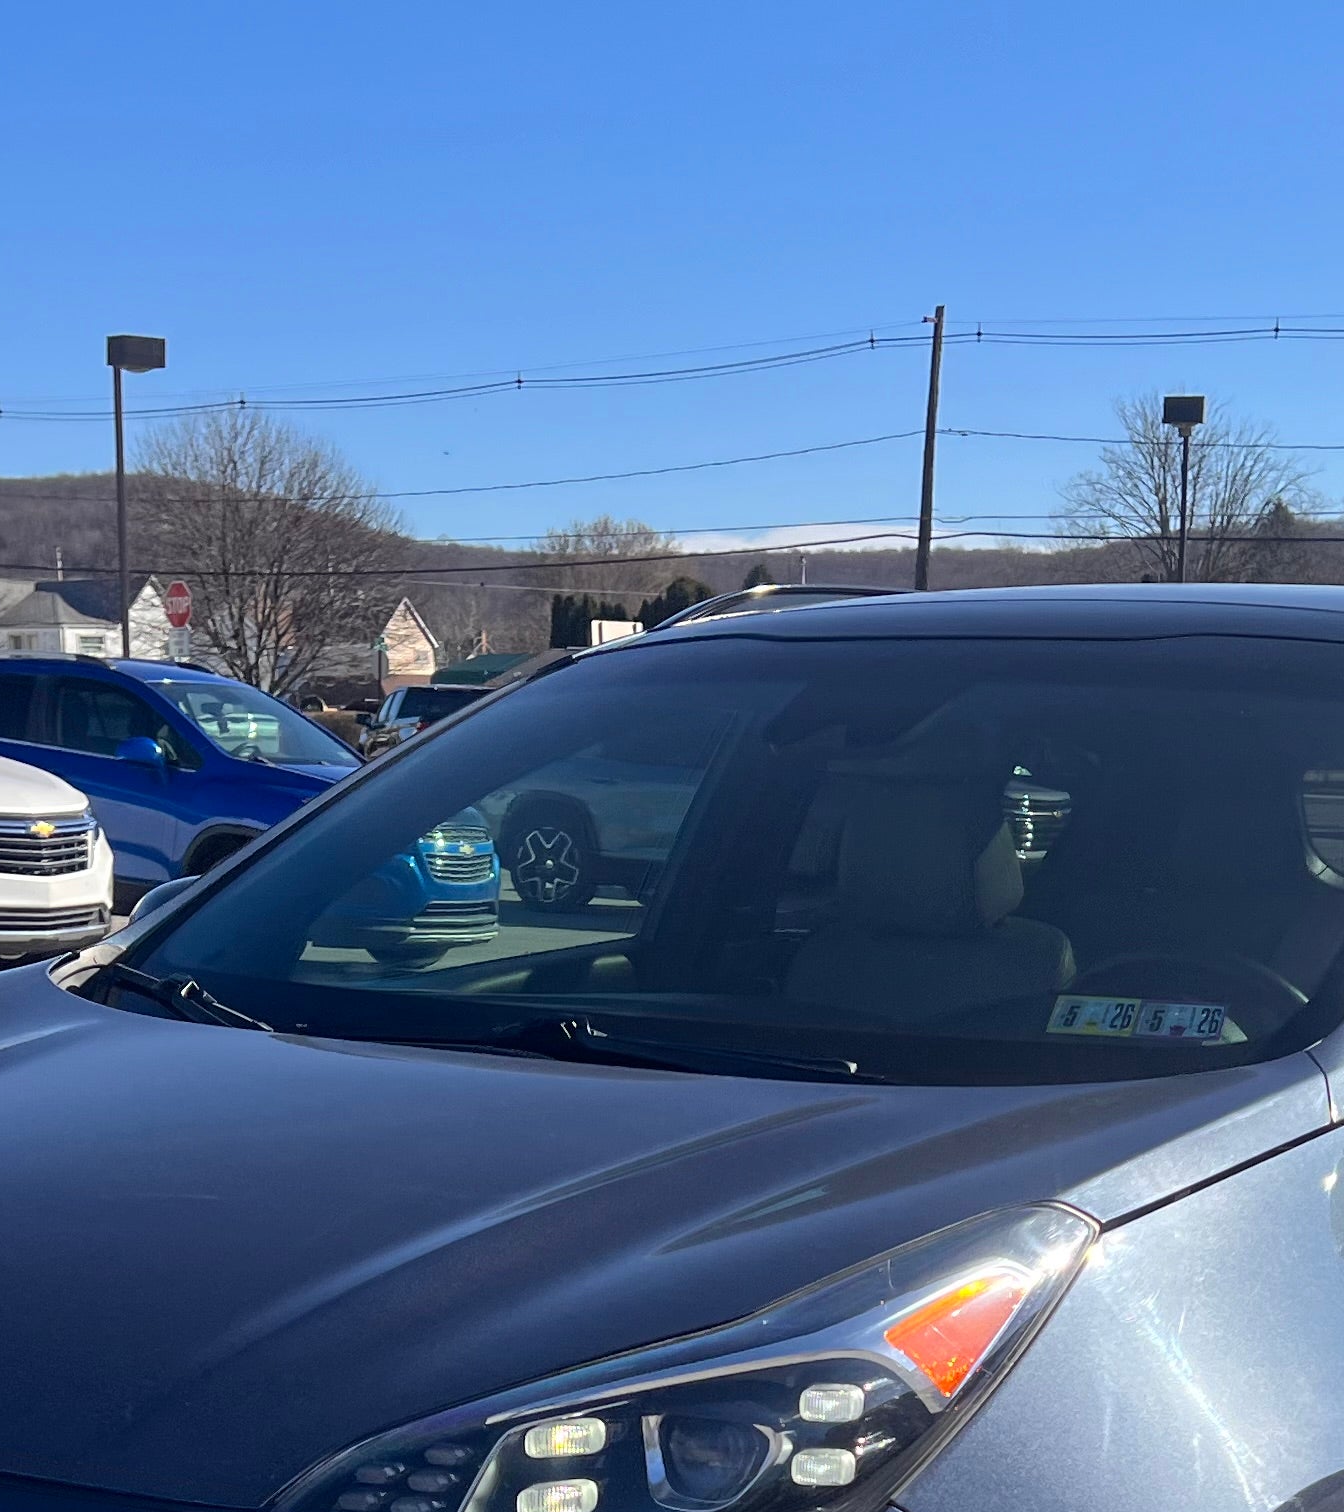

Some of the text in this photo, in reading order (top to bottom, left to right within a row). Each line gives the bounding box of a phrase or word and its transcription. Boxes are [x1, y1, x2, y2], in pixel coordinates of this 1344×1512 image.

[1062, 1003, 1135, 1029] 5 26
[1149, 1007, 1222, 1034] 5 26
